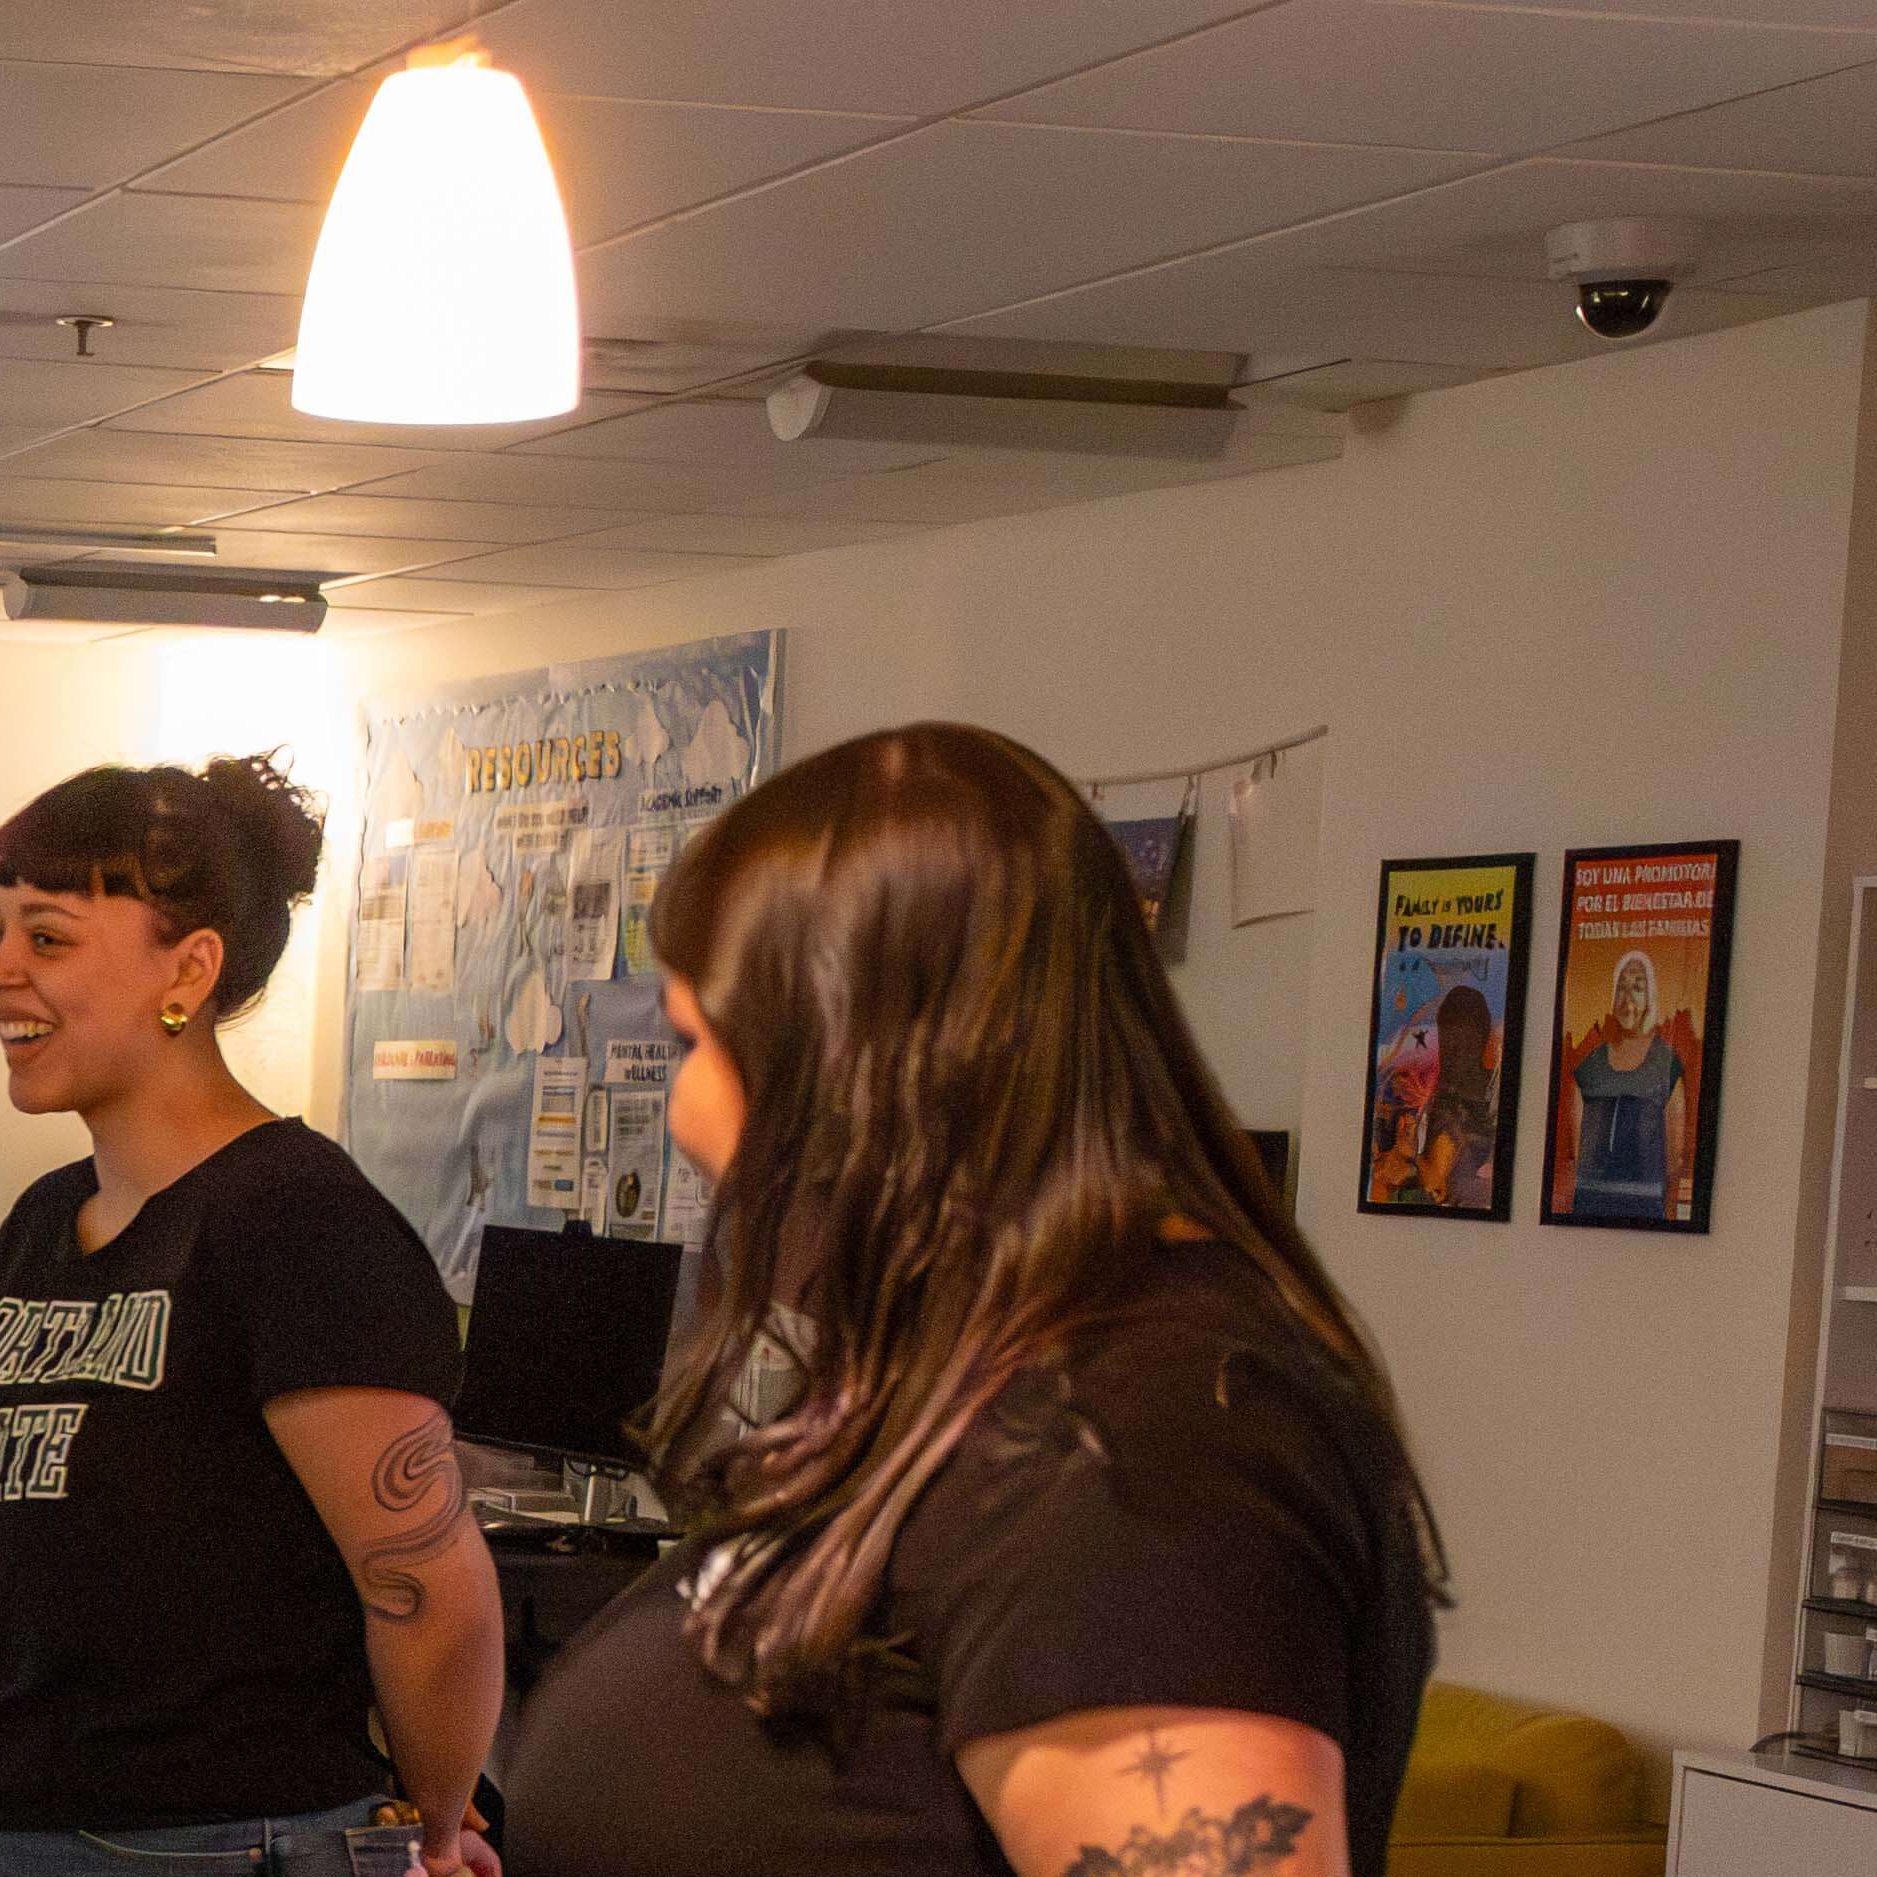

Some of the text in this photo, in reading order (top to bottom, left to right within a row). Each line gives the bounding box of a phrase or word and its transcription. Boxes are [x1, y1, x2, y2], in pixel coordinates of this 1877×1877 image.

[466, 730, 622, 793] RESOURCES
[1575, 861, 1717, 886] SOY UNA PROMOTOR
[1395, 894, 1439, 917] FAMILY
[1456, 888, 1504, 915] YOURS
[1576, 896, 1603, 913] POR
[1605, 894, 1620, 912] EL
[1398, 923, 1505, 952] TO DEFINE.
[1578, 921, 1620, 940] TODAS
